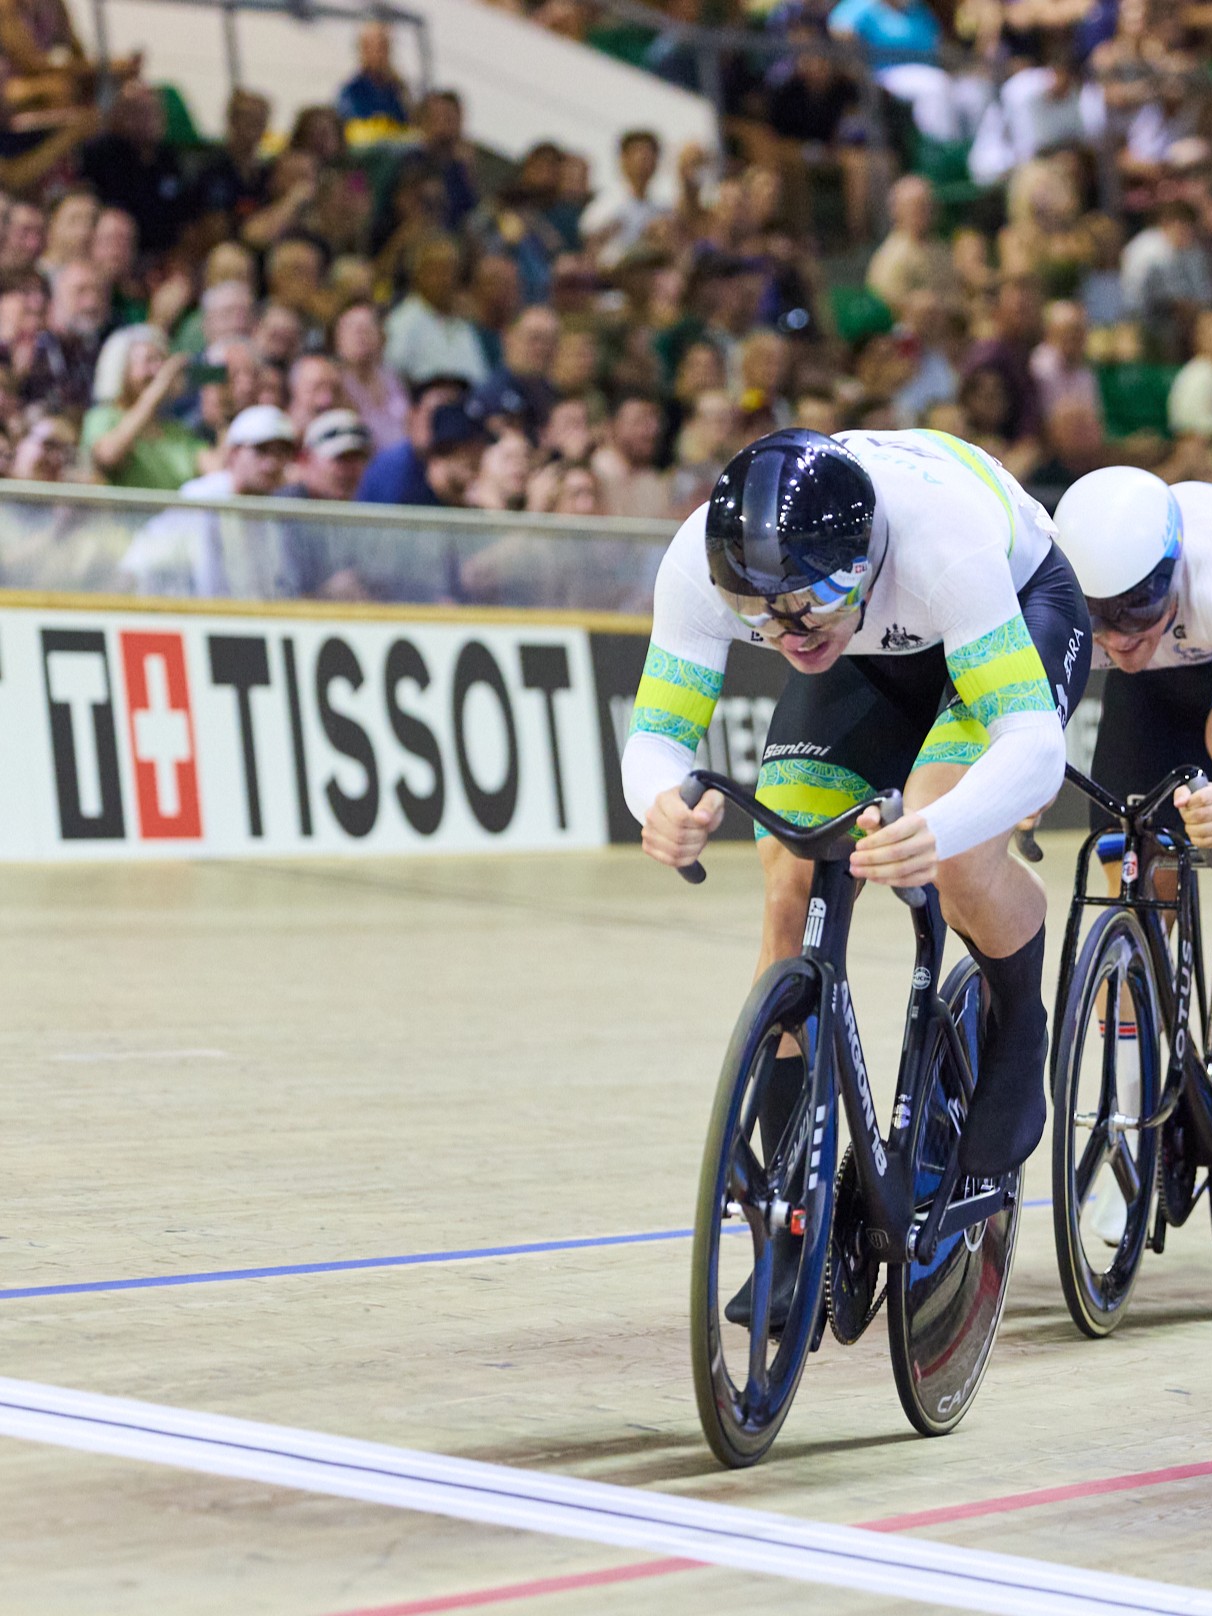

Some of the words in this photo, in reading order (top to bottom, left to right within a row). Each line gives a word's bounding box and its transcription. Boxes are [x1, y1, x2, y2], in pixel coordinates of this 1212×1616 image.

[207, 634, 571, 839] TISSOT
[763, 741, 832, 760] Santini
[840, 980, 875, 1129] ARGON
[871, 1126, 889, 1178] 18
